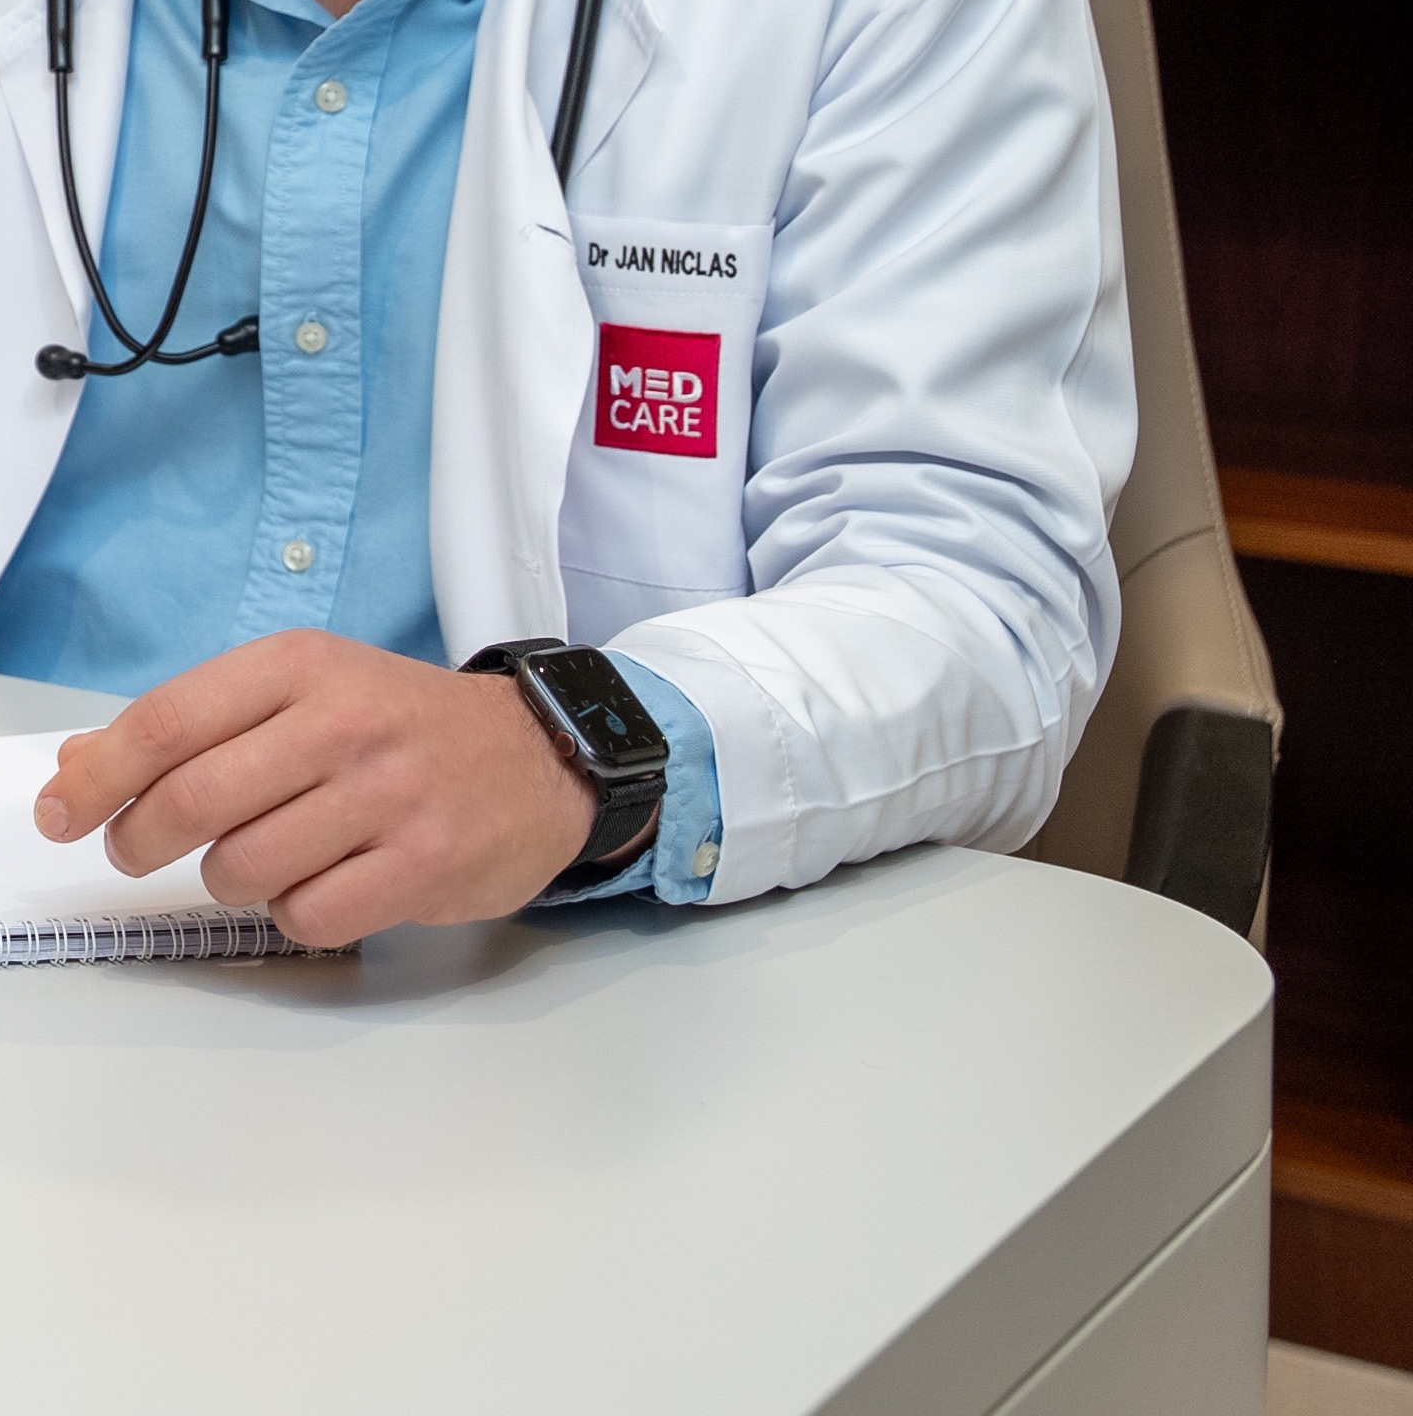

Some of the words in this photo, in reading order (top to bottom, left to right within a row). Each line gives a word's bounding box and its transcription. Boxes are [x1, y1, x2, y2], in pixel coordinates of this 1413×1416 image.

[588, 242, 609, 267] Dr
[615, 245, 654, 273] JAN
[661, 248, 738, 279] NICLAS
[609, 364, 703, 404] MED
[609, 399, 703, 438] CARE
